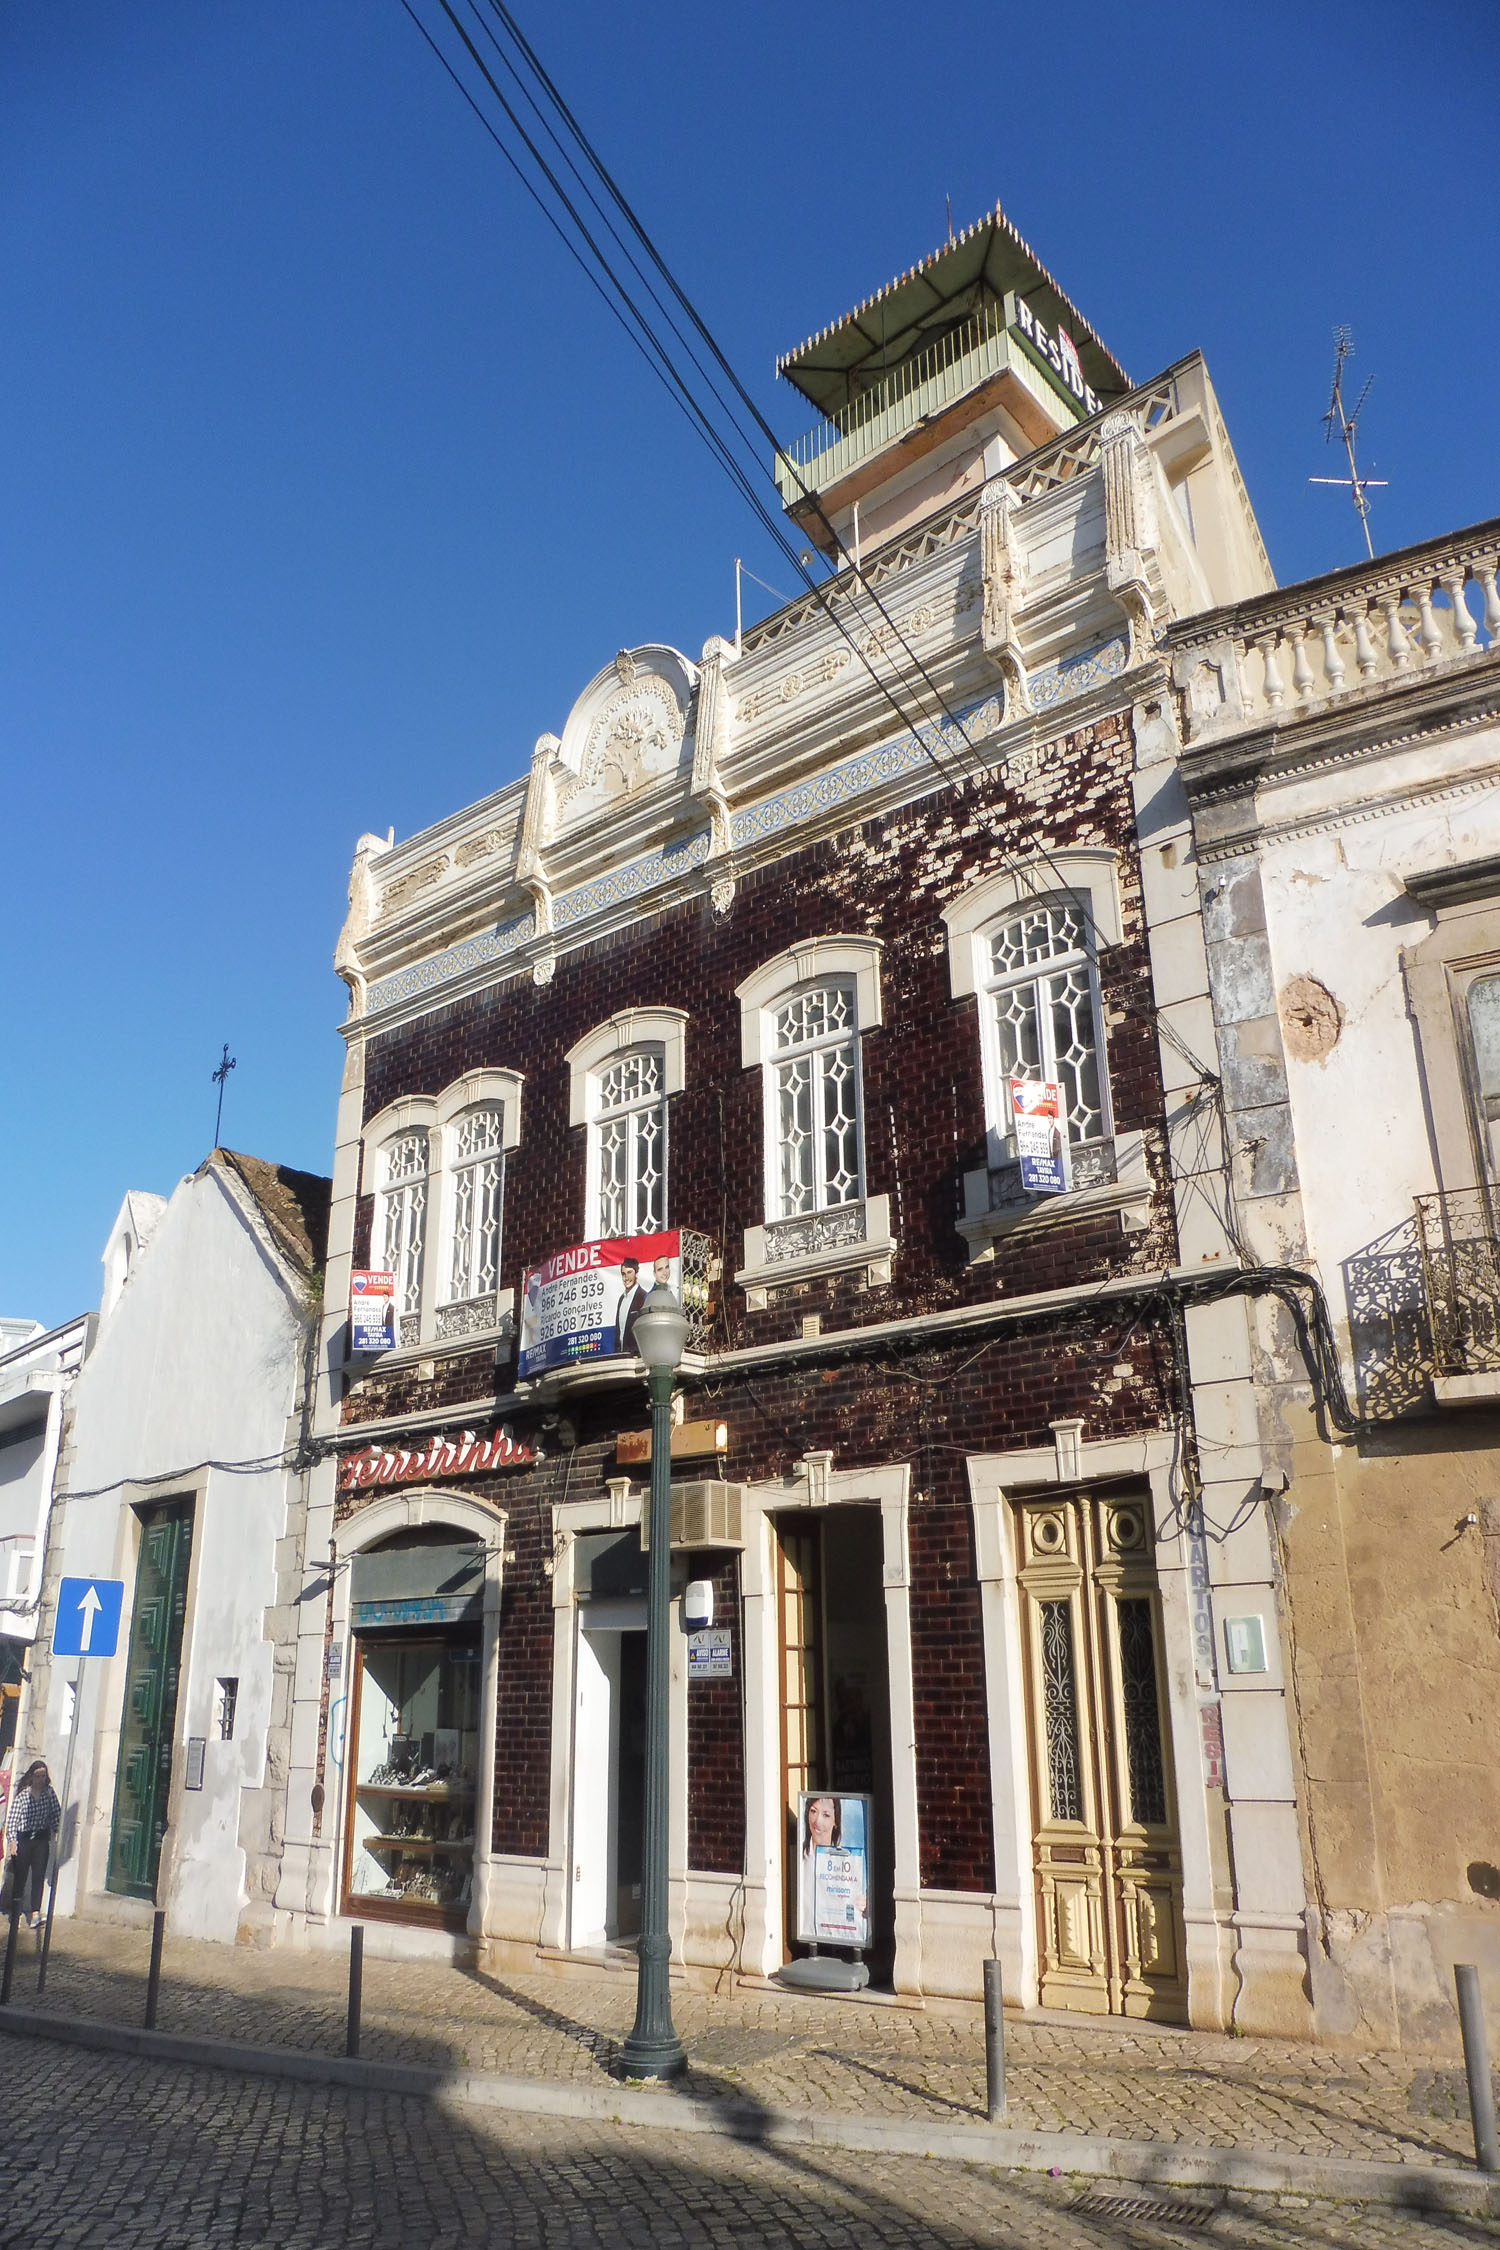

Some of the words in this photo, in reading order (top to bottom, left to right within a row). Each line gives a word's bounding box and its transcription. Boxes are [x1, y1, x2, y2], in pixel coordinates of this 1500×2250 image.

[1018, 298, 1104, 416] RESIDE
[1031, 1158, 1056, 1168] RE/MAX
[1028, 1174, 1038, 1183] 281
[1038, 1174, 1049, 1184] 320
[548, 1244, 602, 1279] VENDE
[367, 1274, 393, 1285] VENDE
[559, 1272, 598, 1289] Fernandes
[541, 1284, 558, 1297] André
[558, 1287, 577, 1306] 246
[581, 1282, 605, 1299] 939
[562, 1301, 603, 1318] Gonçalves
[540, 1323, 554, 1341] 926
[557, 1316, 577, 1334] 608
[580, 1312, 603, 1329] 753
[541, 1311, 561, 1326] Ricardo
[567, 1336, 577, 1346] 281
[578, 1334, 589, 1344] 320
[526, 1343, 547, 1360] RE/MAX
[342, 1428, 542, 1489] Ferreirinha
[827, 1860, 833, 1872] 8
[841, 1862, 851, 1873] 10
